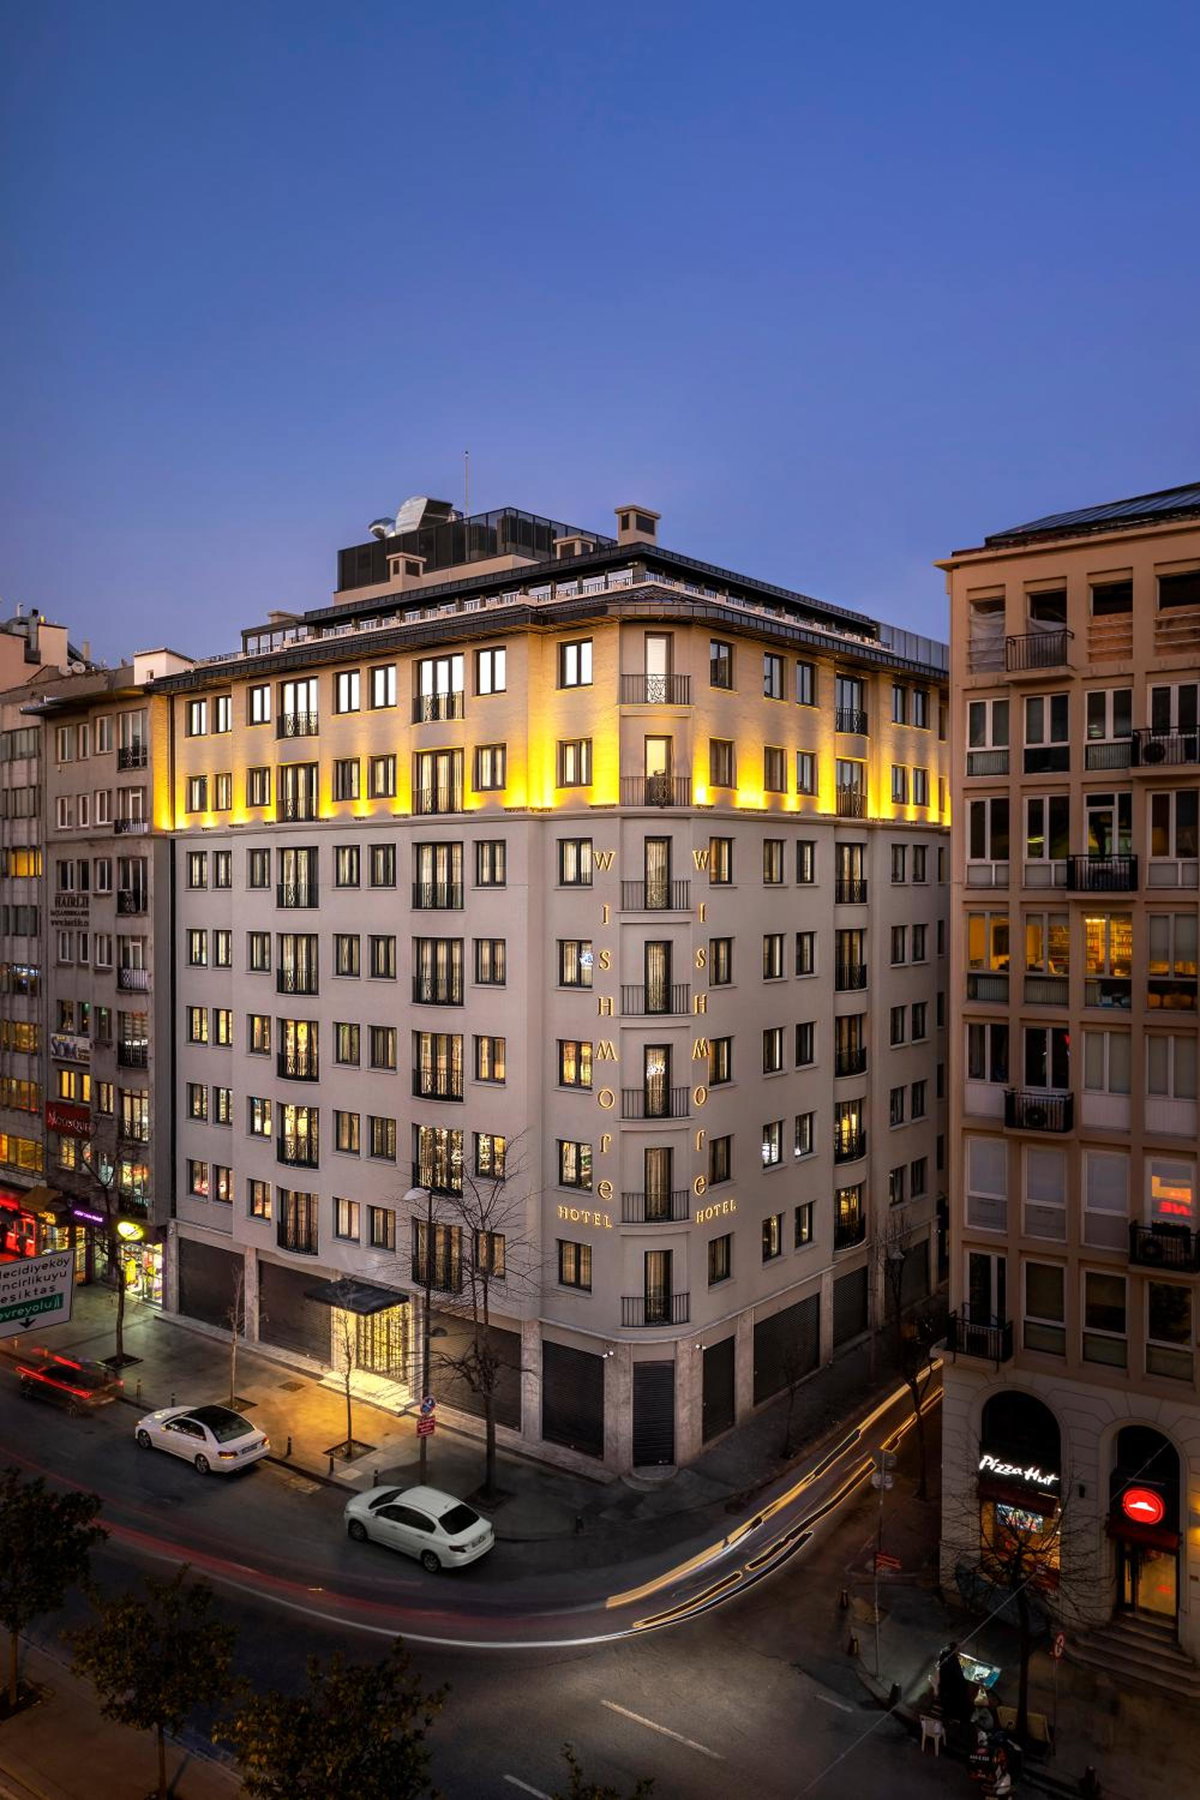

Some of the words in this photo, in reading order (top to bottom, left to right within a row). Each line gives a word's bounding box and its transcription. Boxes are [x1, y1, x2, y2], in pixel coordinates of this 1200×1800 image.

[557, 1205, 612, 1228] HOTEL
[696, 1199, 737, 1224] HOTEL
[979, 1455, 1022, 1475] Pizza
[1024, 1467, 1059, 1485] Hut
